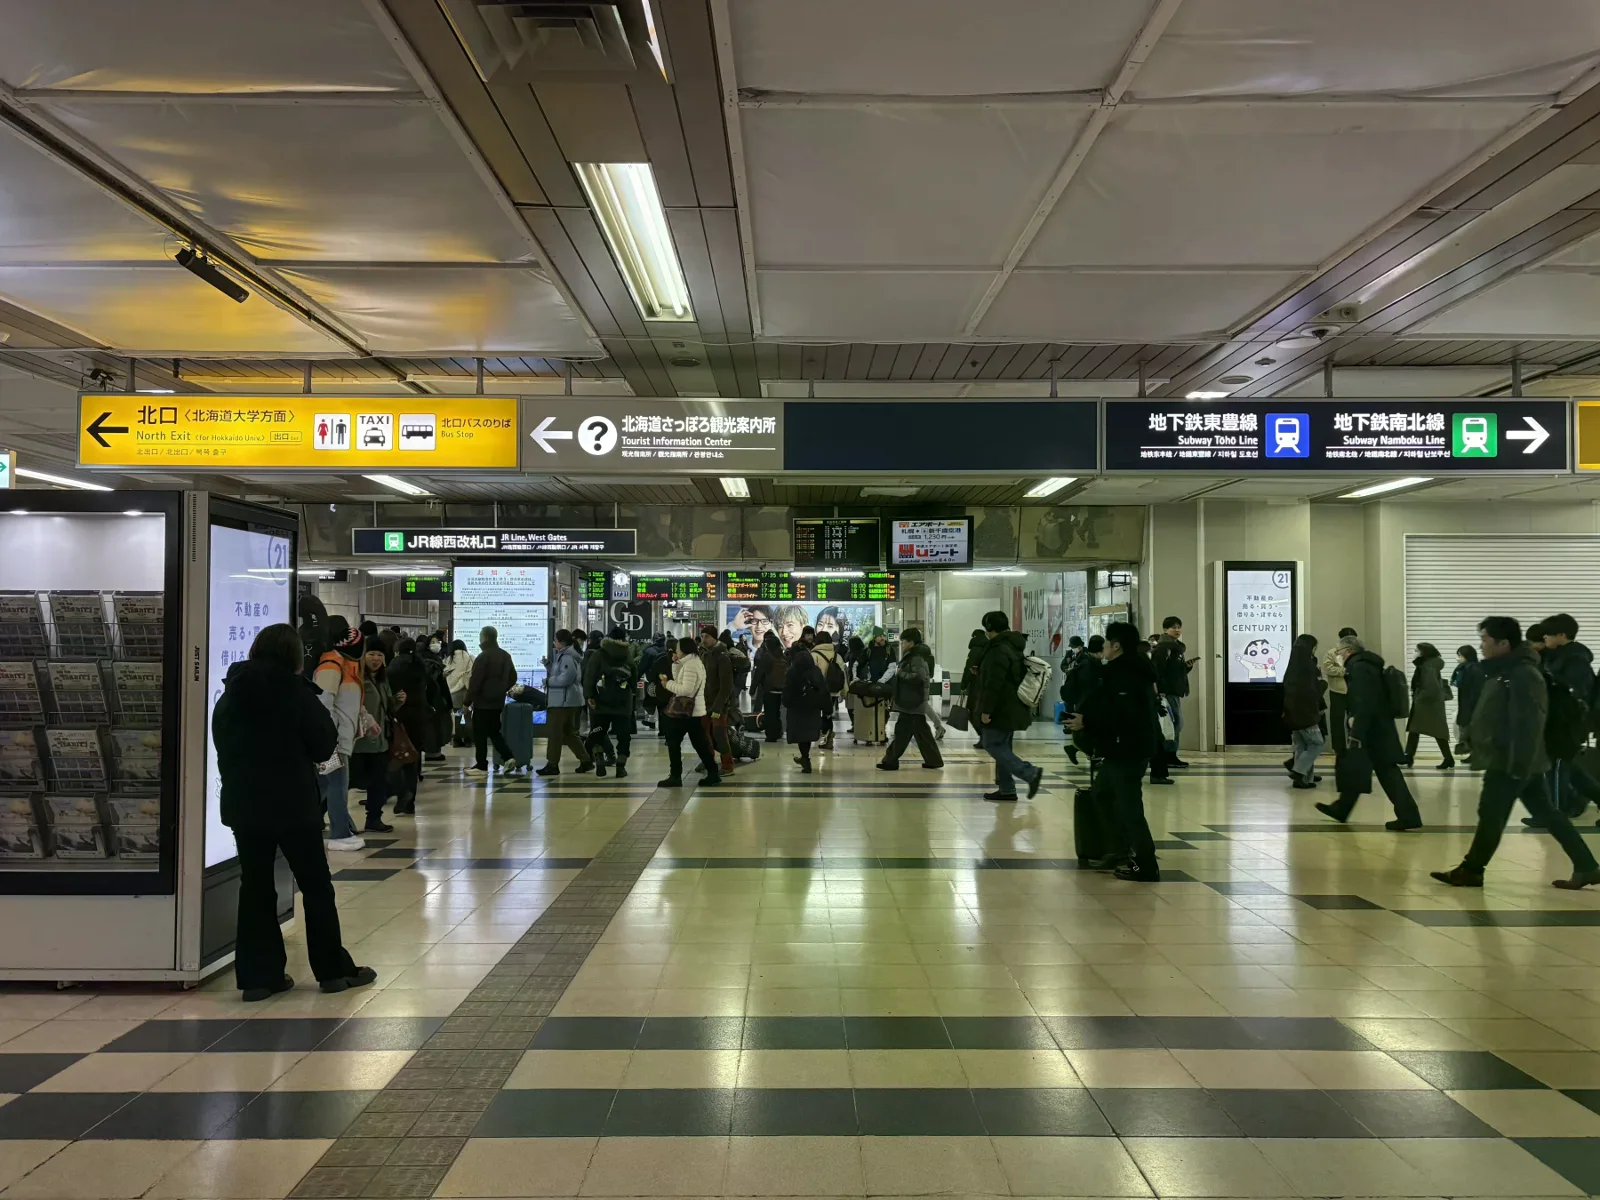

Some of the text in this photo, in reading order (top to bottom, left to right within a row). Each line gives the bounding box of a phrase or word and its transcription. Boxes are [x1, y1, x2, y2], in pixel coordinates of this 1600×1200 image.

[137, 405, 177, 425] 北口
[360, 416, 390, 424] TAXI
[441, 418, 512, 428] 北口バスのりば
[621, 415, 776, 434] 北海道さっぽろ観光案内所
[1148, 412, 1258, 432] 地下鉄東豊線
[1334, 412, 1445, 432] 地下鉄南北線
[136, 430, 166, 440] North
[170, 430, 191, 440] Exit
[456, 430, 474, 438] Stop
[621, 436, 732, 446] Tourist Information Center
[1178, 435, 1212, 446] Subway
[1239, 435, 1258, 445] Line
[1343, 435, 1446, 446] Subway Namboku Line
[408, 535, 496, 549] JR線西改札口
[274, 544, 287, 569] 21
[1277, 573, 1288, 583] 21
[235, 602, 269, 617] 不動産の
